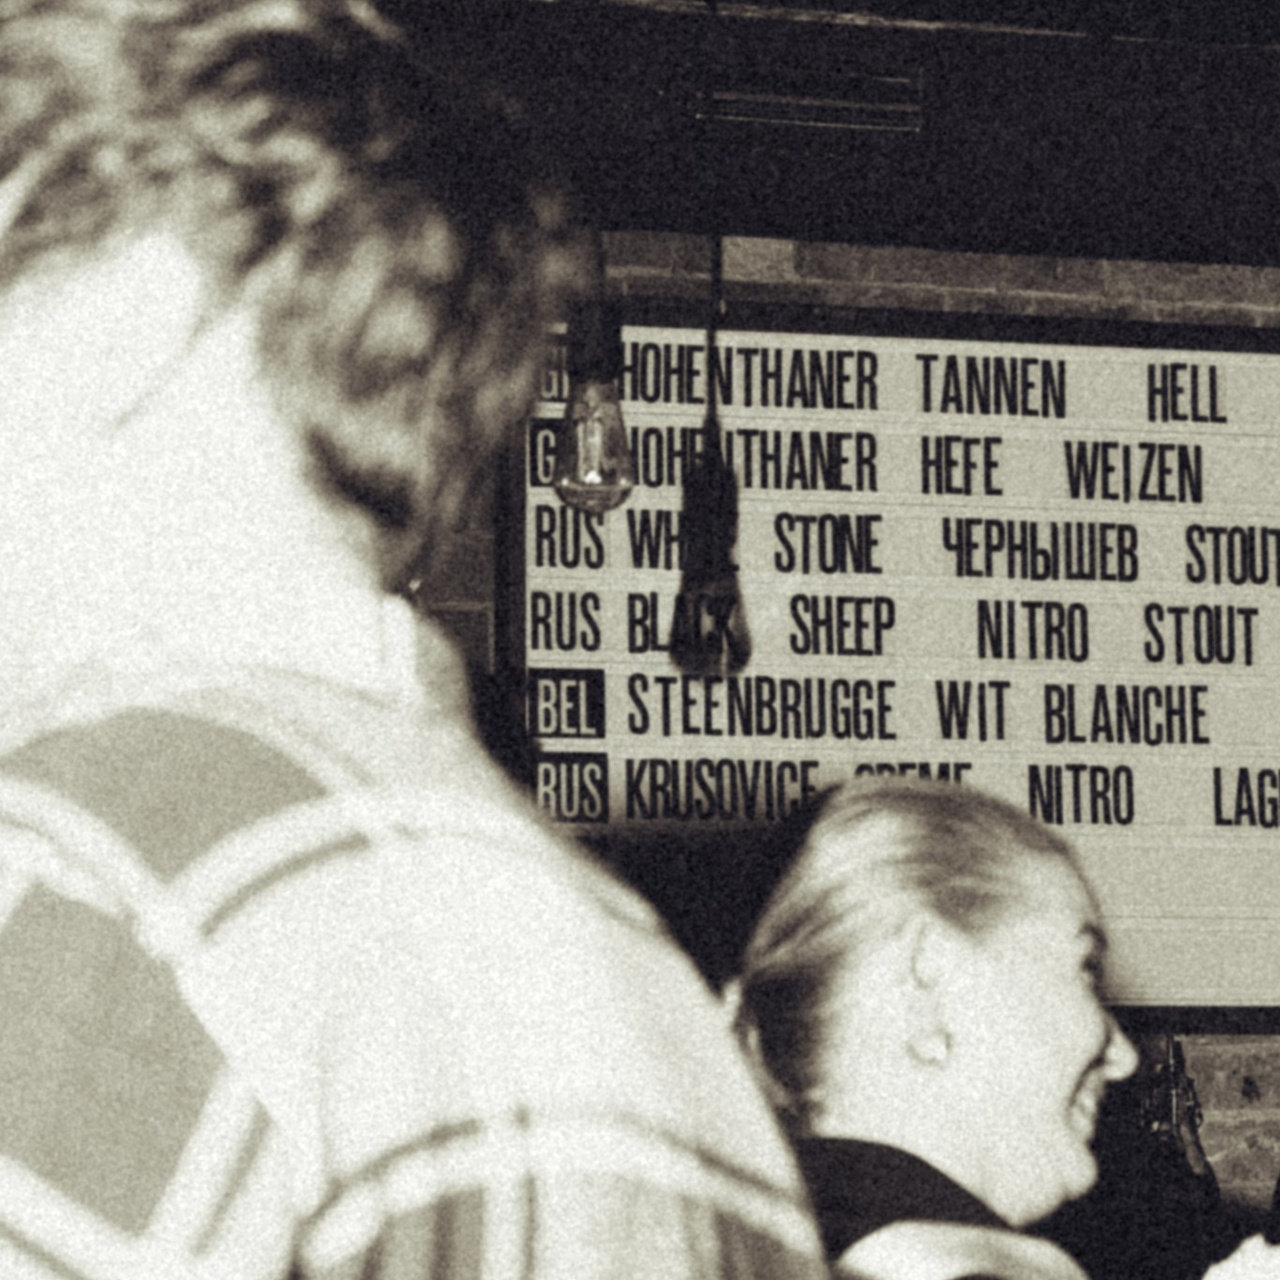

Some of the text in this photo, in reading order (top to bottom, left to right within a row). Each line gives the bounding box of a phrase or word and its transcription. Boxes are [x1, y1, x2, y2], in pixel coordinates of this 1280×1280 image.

[916, 353, 1066, 418] TANNEN
[1147, 363, 1227, 423] HELL
[921, 435, 1003, 495] HEFE
[1064, 441, 1203, 503] WEIZEN
[535, 505, 604, 569] RUS
[774, 513, 882, 574] STONE
[531, 591, 601, 652] RUS
[790, 595, 895, 656] SHEEP
[977, 600, 1089, 662] NITRO
[1144, 603, 1259, 666] STOUT
[537, 678, 594, 735] BEL
[627, 673, 896, 741] STEENBRUGGE
[935, 680, 1011, 741] WIT
[1045, 684, 1210, 746] BLANCHE
[537, 762, 602, 818] RUS
[1028, 763, 1134, 825] NITRO
